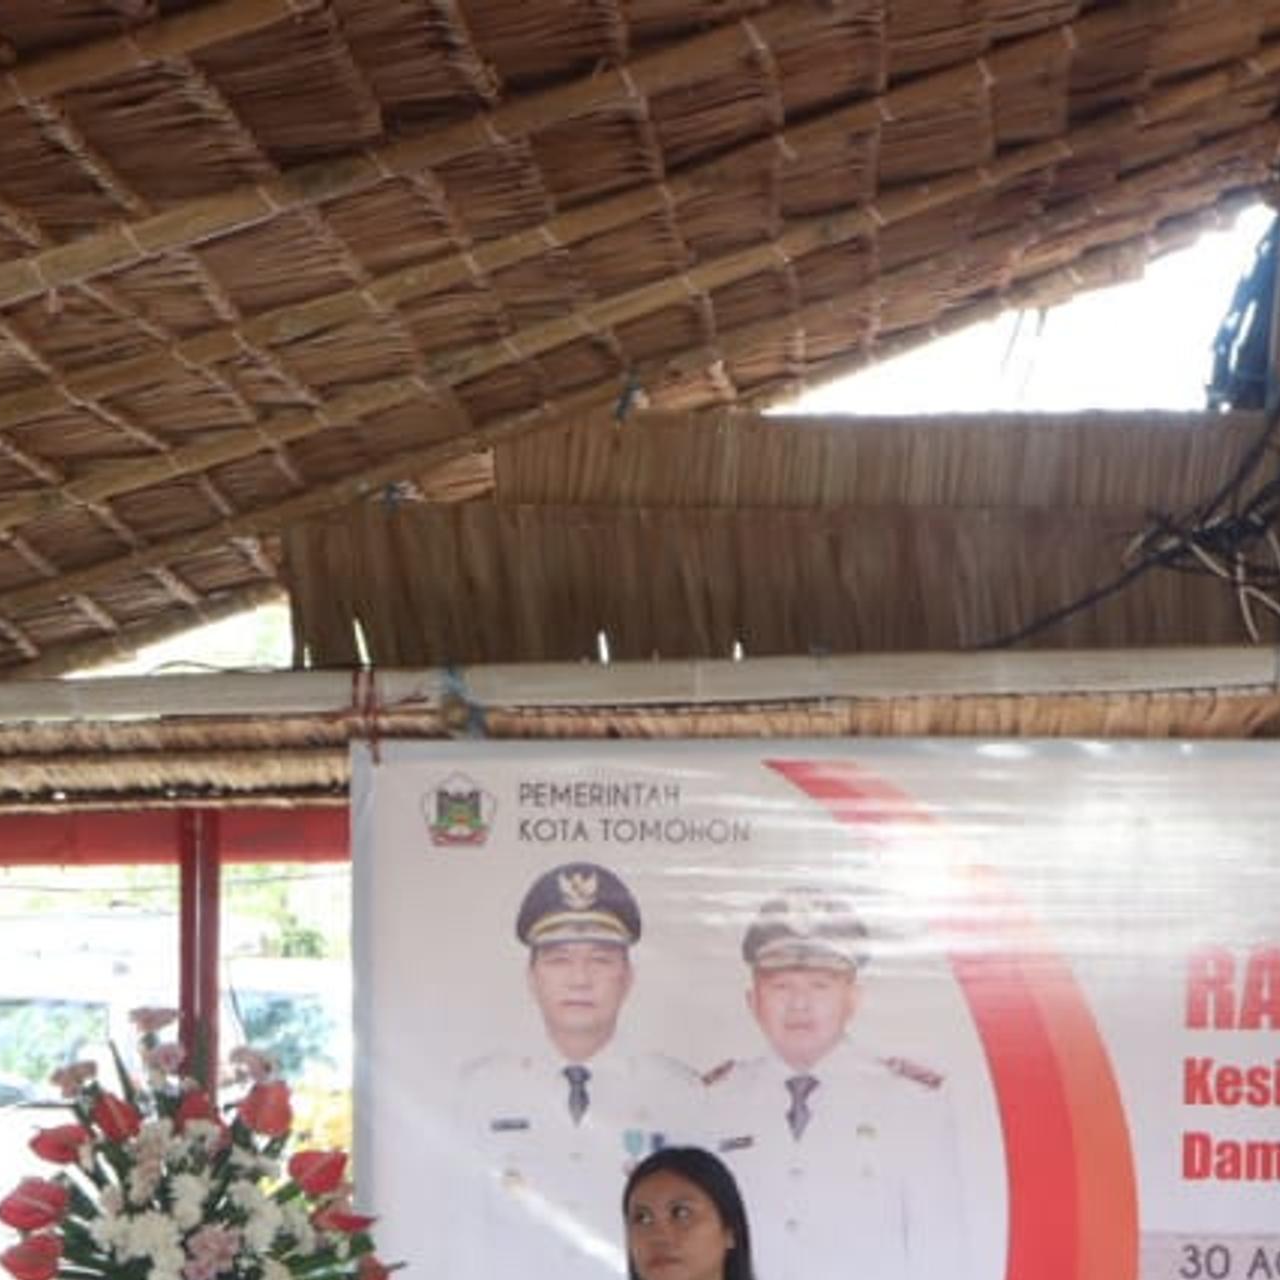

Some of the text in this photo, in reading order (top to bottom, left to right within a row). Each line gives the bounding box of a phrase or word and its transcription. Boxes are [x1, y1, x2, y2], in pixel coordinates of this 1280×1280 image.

[517, 782, 681, 809] PEMERINTAH
[518, 819, 750, 844] KOTA TOMOHON
[1178, 1244, 1232, 1280] 30
